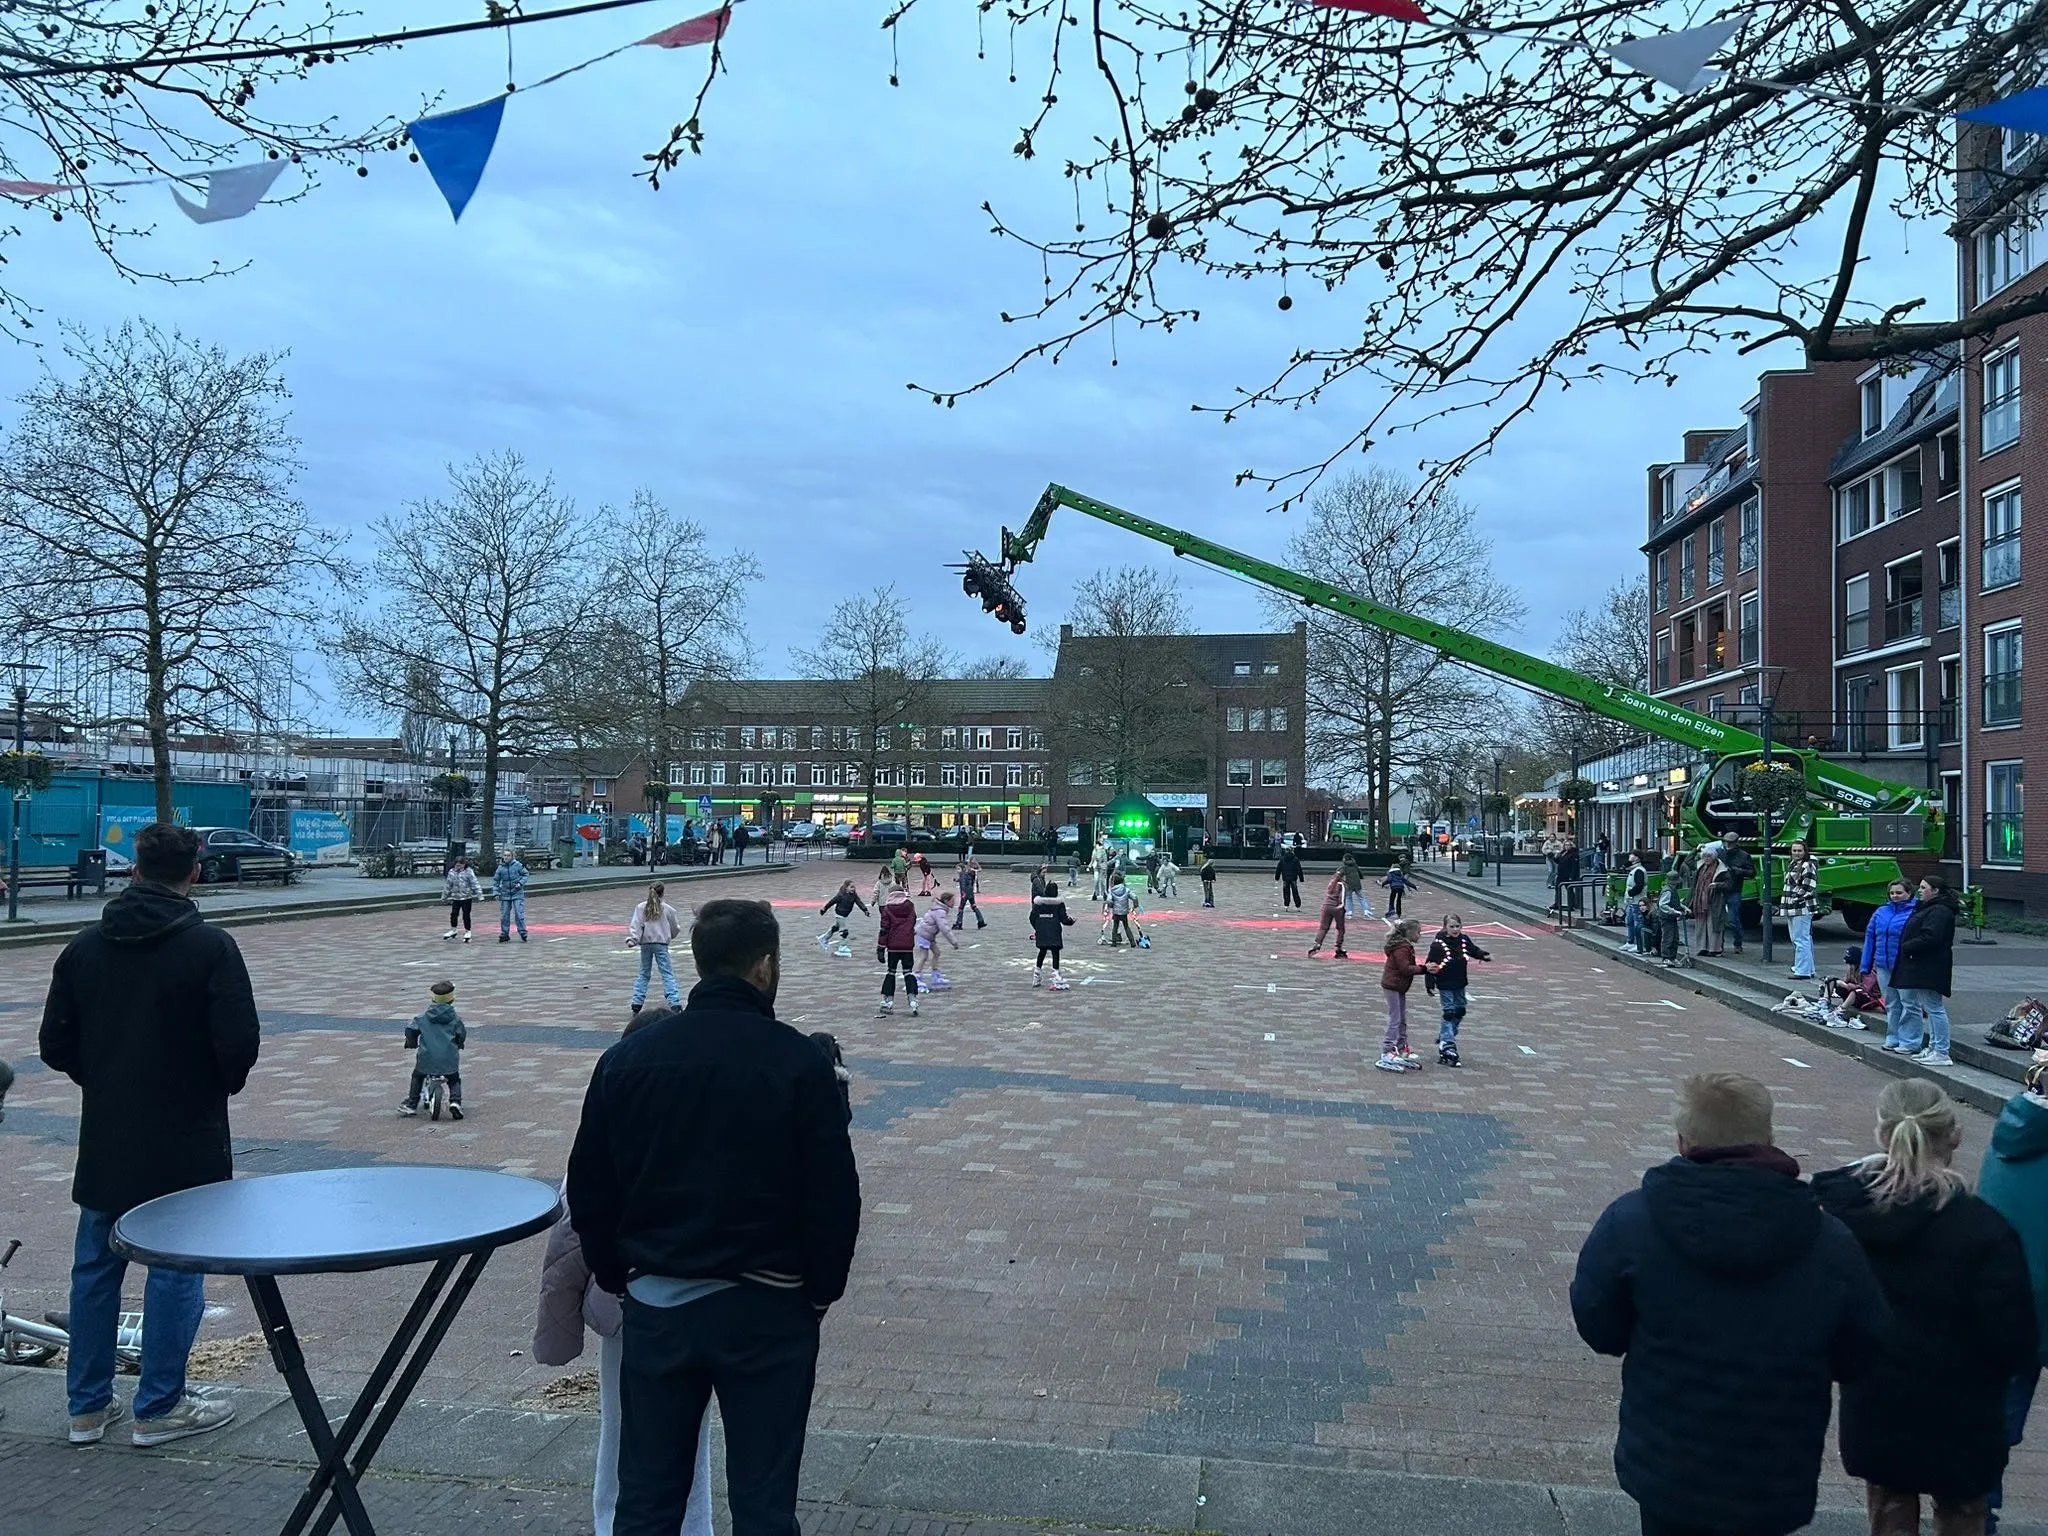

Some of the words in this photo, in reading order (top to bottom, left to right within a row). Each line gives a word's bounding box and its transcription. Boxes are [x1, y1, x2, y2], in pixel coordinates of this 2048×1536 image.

[1620, 693, 1647, 710] Joan
[1649, 704, 1669, 719] van
[1670, 712, 1692, 727] den
[1694, 720, 1725, 739] Elzen
[1836, 790, 1872, 808] 50.26
